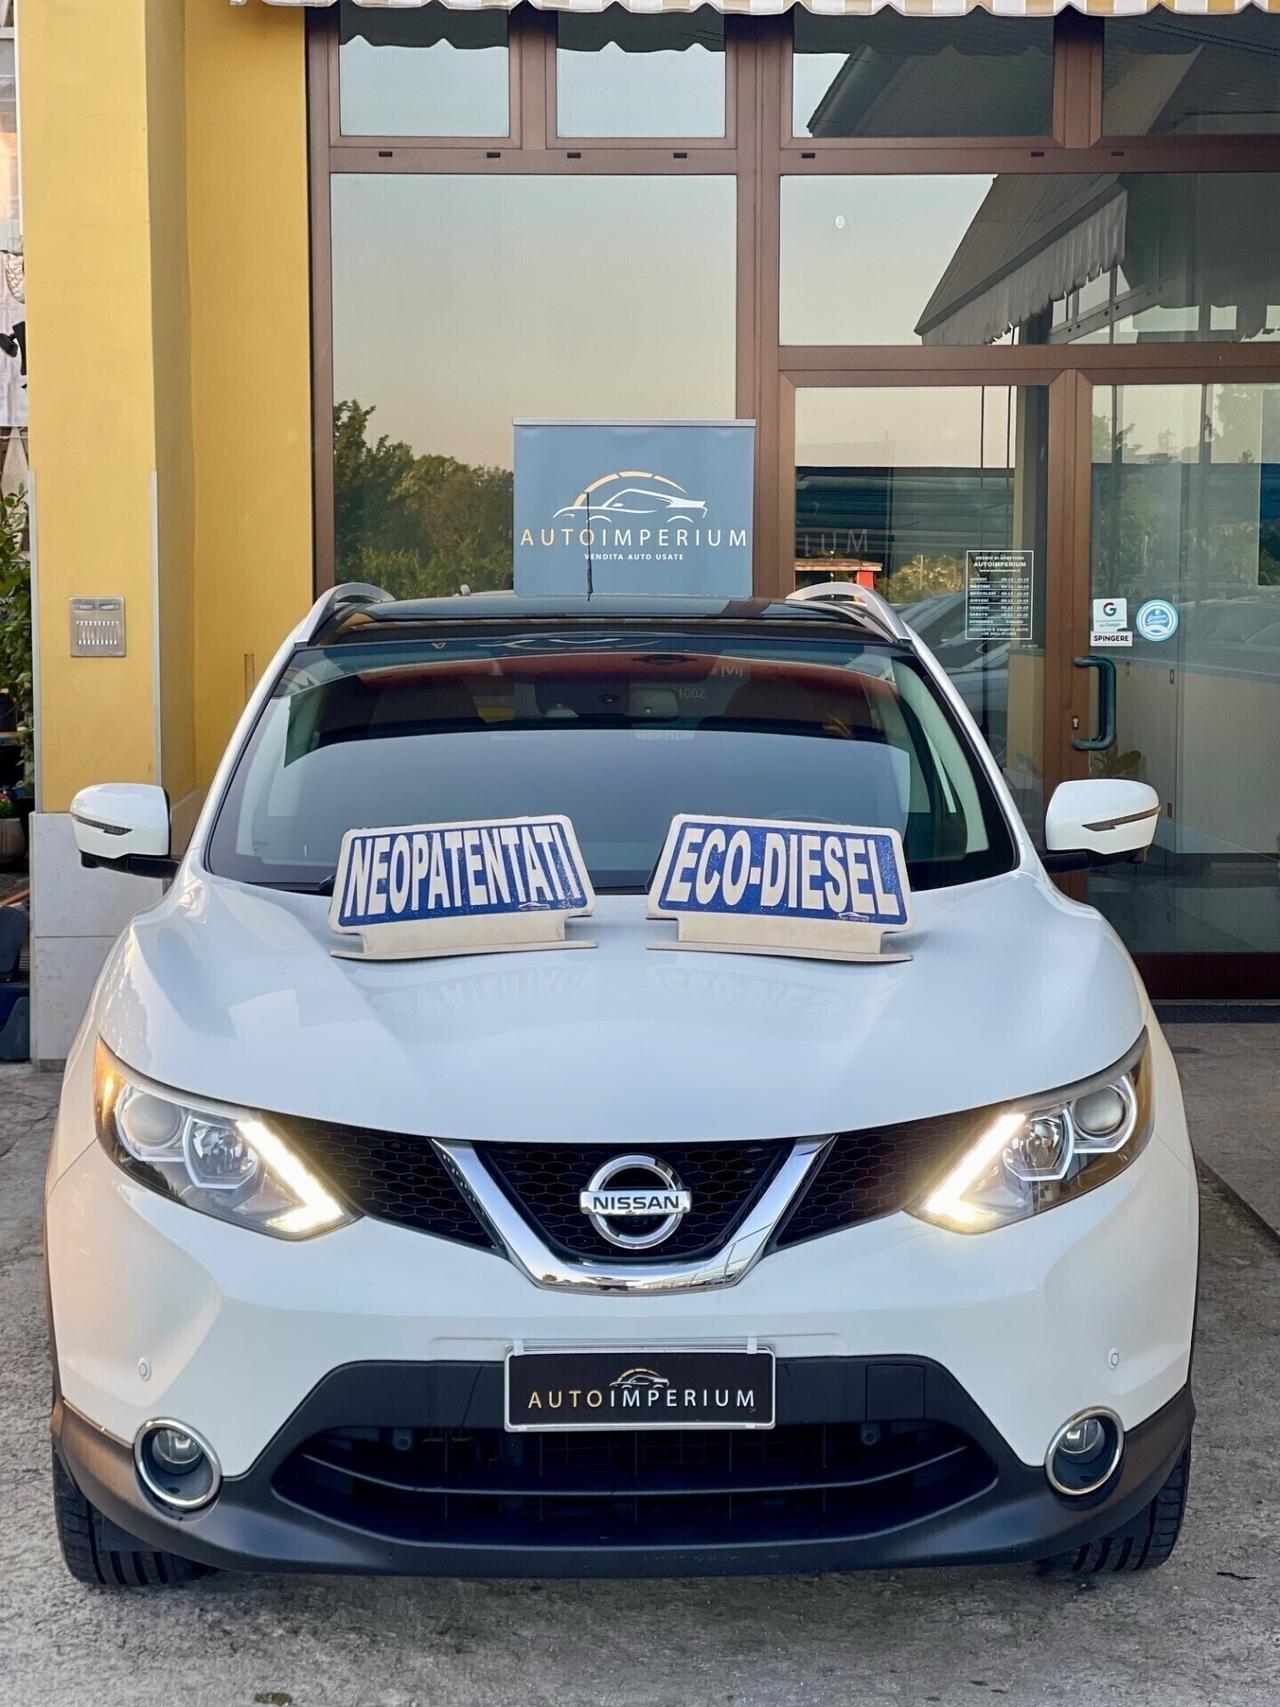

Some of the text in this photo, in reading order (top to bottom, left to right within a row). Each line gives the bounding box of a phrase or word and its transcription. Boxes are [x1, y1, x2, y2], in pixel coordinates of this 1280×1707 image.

[520, 527, 748, 547] AUTOIMPERIUM
[584, 553, 685, 561] VENDITA AUTO USATE
[1093, 634, 1130, 642] SPINGERE
[343, 824, 581, 918] NEOPATENTATI
[664, 827, 900, 916] ECO-DIESEL
[593, 1195, 680, 1210] NISSAN
[527, 1388, 755, 1409] AUTOIMPERIUM
